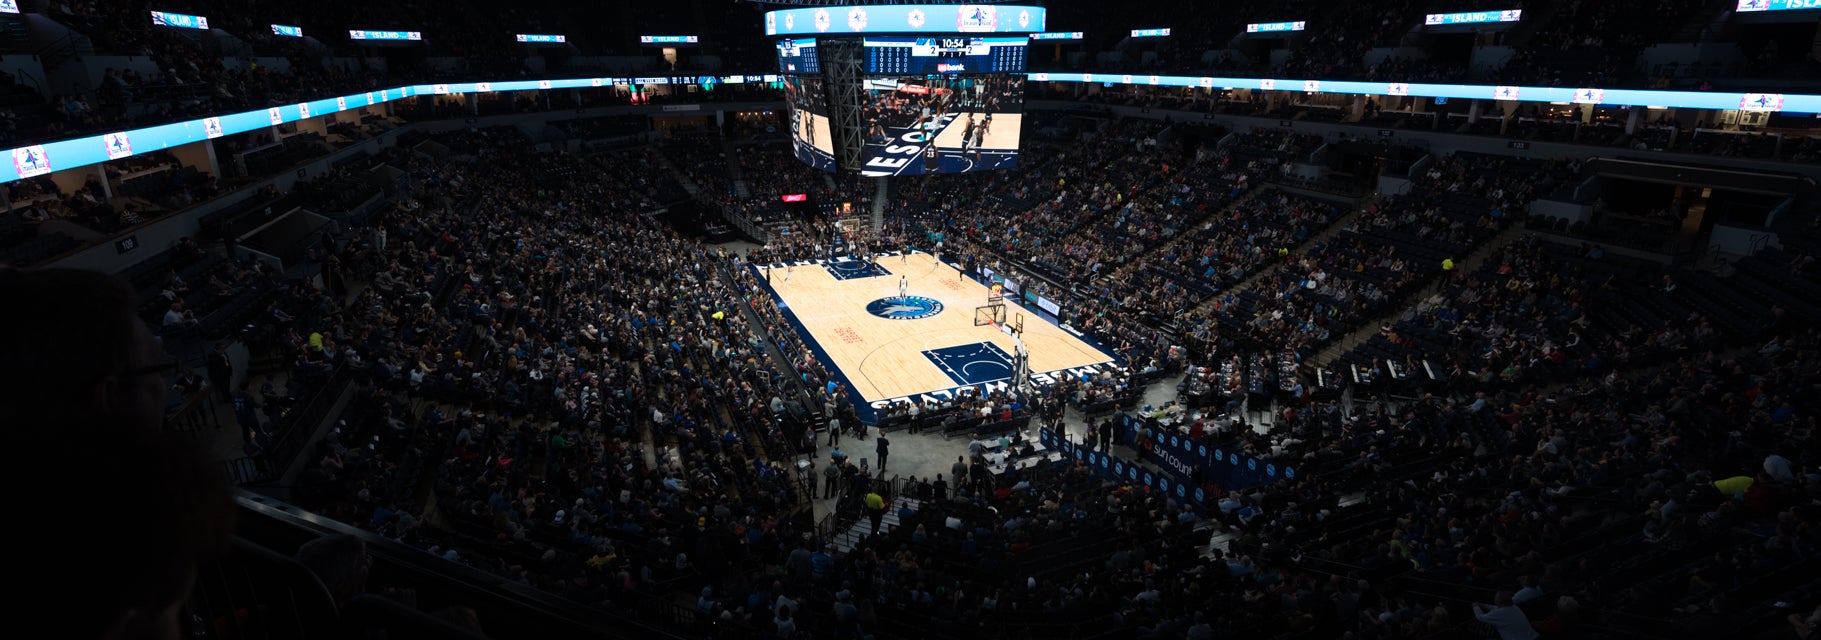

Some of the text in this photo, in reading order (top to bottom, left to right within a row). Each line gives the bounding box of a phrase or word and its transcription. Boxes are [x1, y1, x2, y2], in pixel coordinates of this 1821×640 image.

[1451, 13, 1488, 22] ISLAND
[372, 31, 398, 39] ISLAND
[942, 39, 964, 48] 10:54
[930, 46, 936, 54] 2
[967, 46, 973, 54] 2
[1154, 444, 1168, 462] sun
